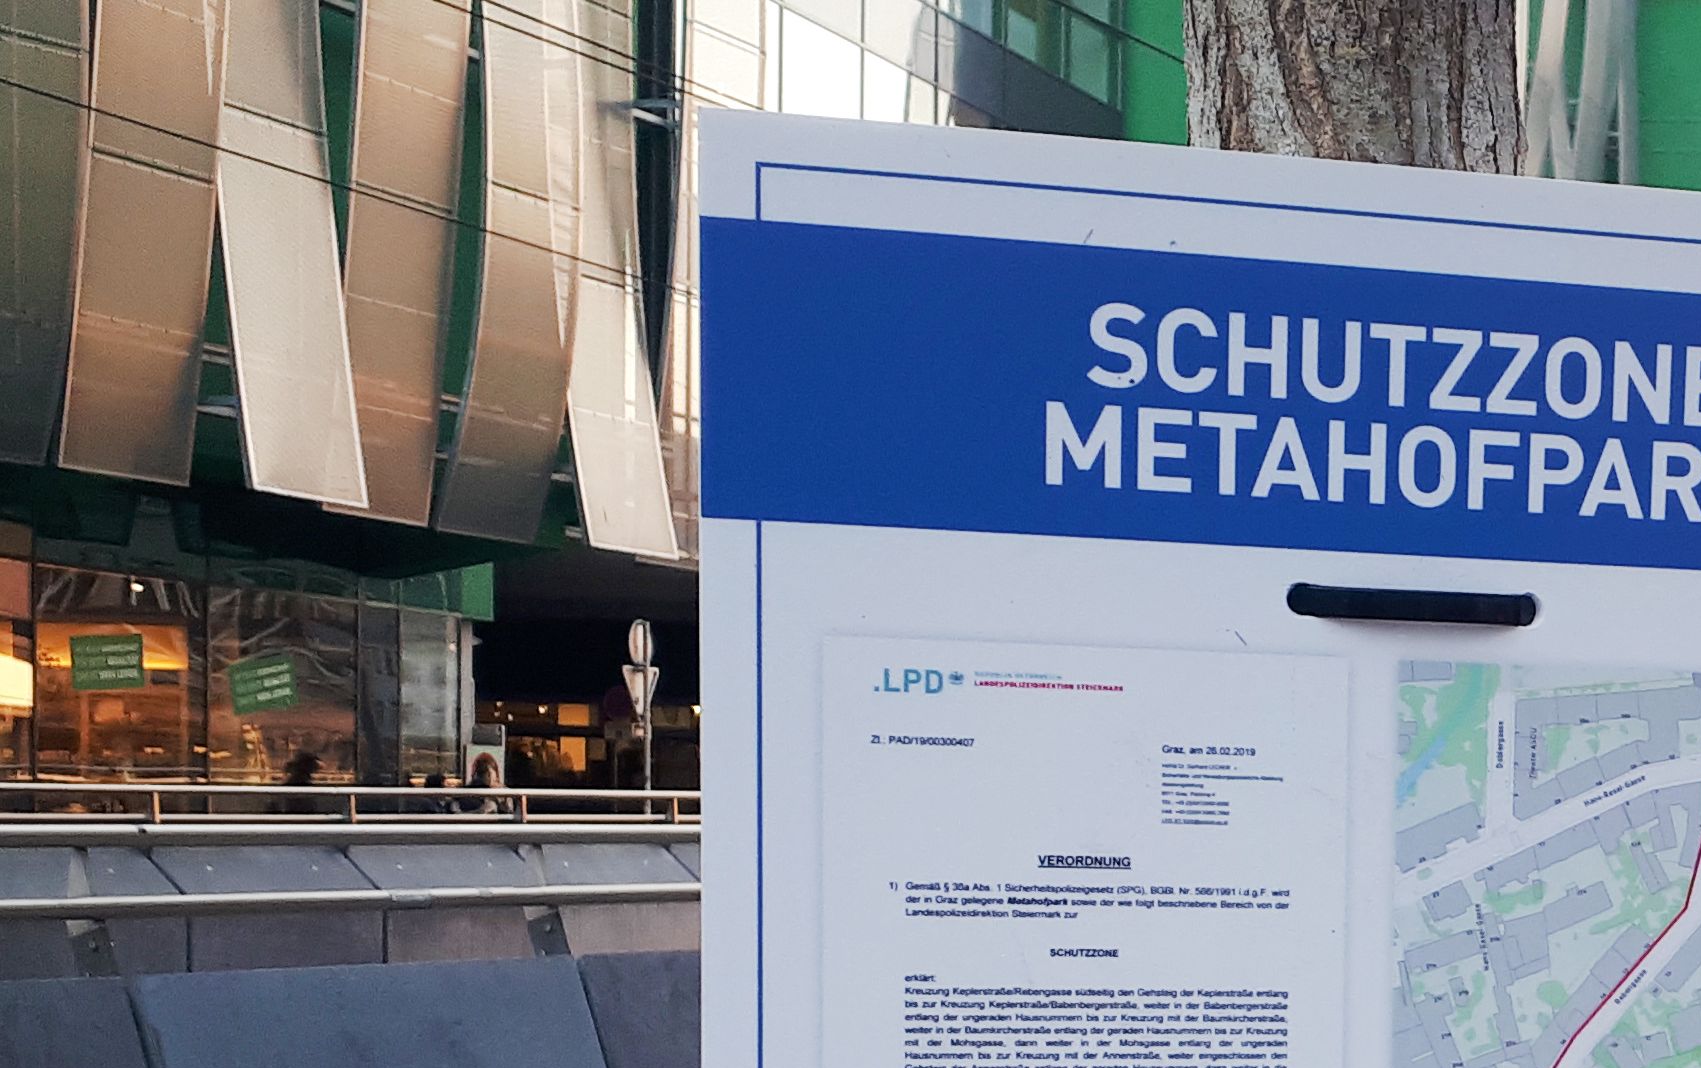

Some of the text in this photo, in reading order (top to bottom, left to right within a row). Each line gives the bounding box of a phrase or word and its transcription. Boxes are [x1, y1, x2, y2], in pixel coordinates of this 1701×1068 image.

[874, 668, 944, 694] .LPD
[1037, 855, 1131, 870] VERORDNUNG
[905, 896, 921, 904] der
[935, 895, 958, 904] Graz
[961, 896, 1004, 906] gelegene
[1007, 896, 1068, 907] Metahofpark
[1099, 899, 1115, 907] der
[1135, 899, 1155, 909] folgt
[1157, 900, 1218, 908] beschriebene
[1220, 900, 1254, 909] Bereich
[1275, 902, 1290, 910] der
[905, 908, 1009, 918] Landespolizeidirektion
[1012, 909, 1061, 919] Steiermark
[1050, 948, 1119, 958] SCHUTZZONE
[904, 1013, 940, 1023] entlang
[943, 1013, 958, 1021] der
[962, 1014, 1012, 1023] ungeraden
[1015, 1013, 1083, 1022] Hausnummern
[1086, 1014, 1099, 1022] bis
[1120, 1014, 1164, 1024] Kreuzung
[904, 1026, 933, 1034] weiter
[946, 1026, 962, 1034] der
[1053, 1027, 1088, 1036] entlang
[1106, 1027, 1144, 1036] geraden
[1146, 1027, 1212, 1035] Hausnummern
[1246, 1027, 1288, 1037] Kreuzung
[904, 1039, 919, 1047] mit
[926, 1039, 943, 1047] der
[1014, 1039, 1038, 1047] dann
[1045, 1039, 1073, 1047] weiter
[1119, 1039, 1171, 1049] Mohsgasse
[1178, 1039, 1211, 1049] entlang
[1240, 1040, 1288, 1049] ungeraden
